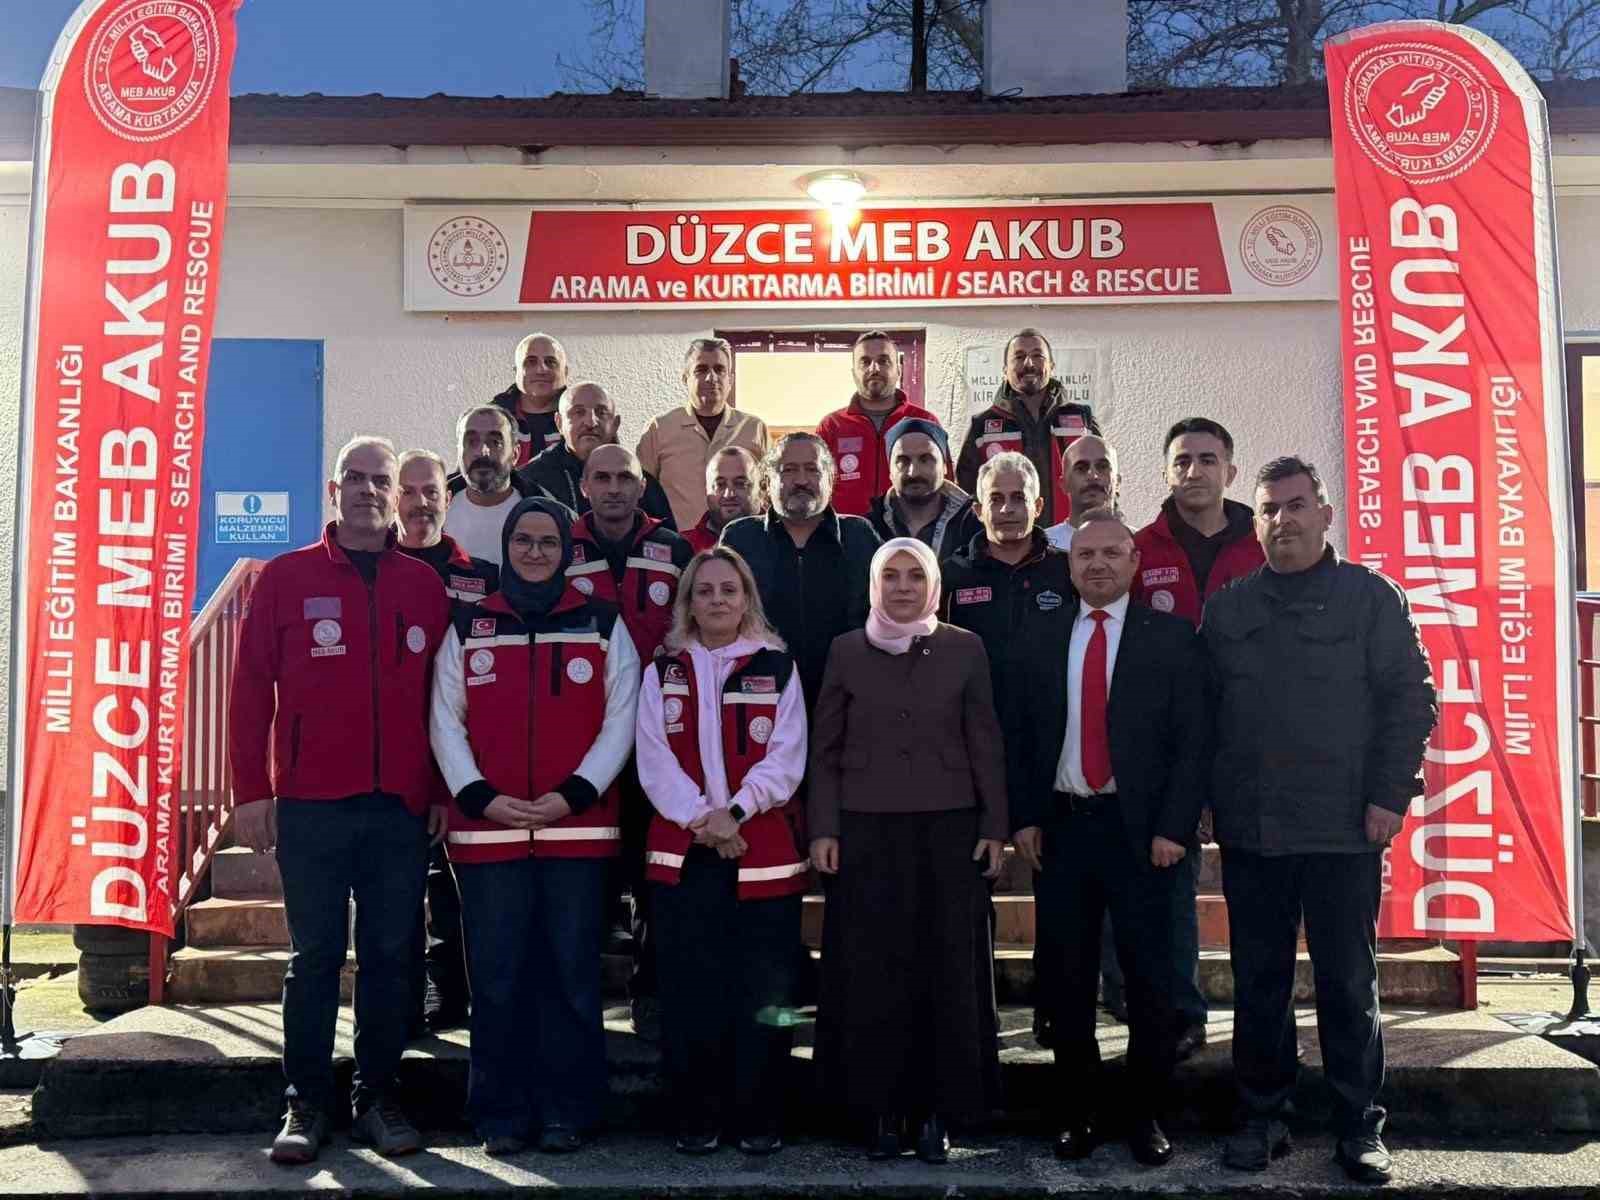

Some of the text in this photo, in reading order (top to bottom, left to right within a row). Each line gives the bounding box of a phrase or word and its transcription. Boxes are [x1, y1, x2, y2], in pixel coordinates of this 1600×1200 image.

[98, 80, 200, 127] ARAMA KURTARMA
[121, 86, 176, 97] MEB AKUB
[183, 201, 214, 315] RESCUE
[550, 267, 1199, 299] ARAMA ve KURTARMA BİRİMİ / SEARCH & RESCUE
[626, 215, 1124, 265] DÜZCE MEB AKUB
[178, 324, 201, 385] AND
[170, 391, 196, 508] SEARCH
[40, 344, 84, 733] MİLLİ EĞİTİM BAKANLIĞI
[71, 159, 176, 922] DÜZCE MEB AKUB
[220, 516, 285, 524] KORUYUCU
[160, 533, 187, 619] BİRİMİ
[158, 627, 181, 784] KURTARMA
[155, 791, 172, 894] ARAMA
